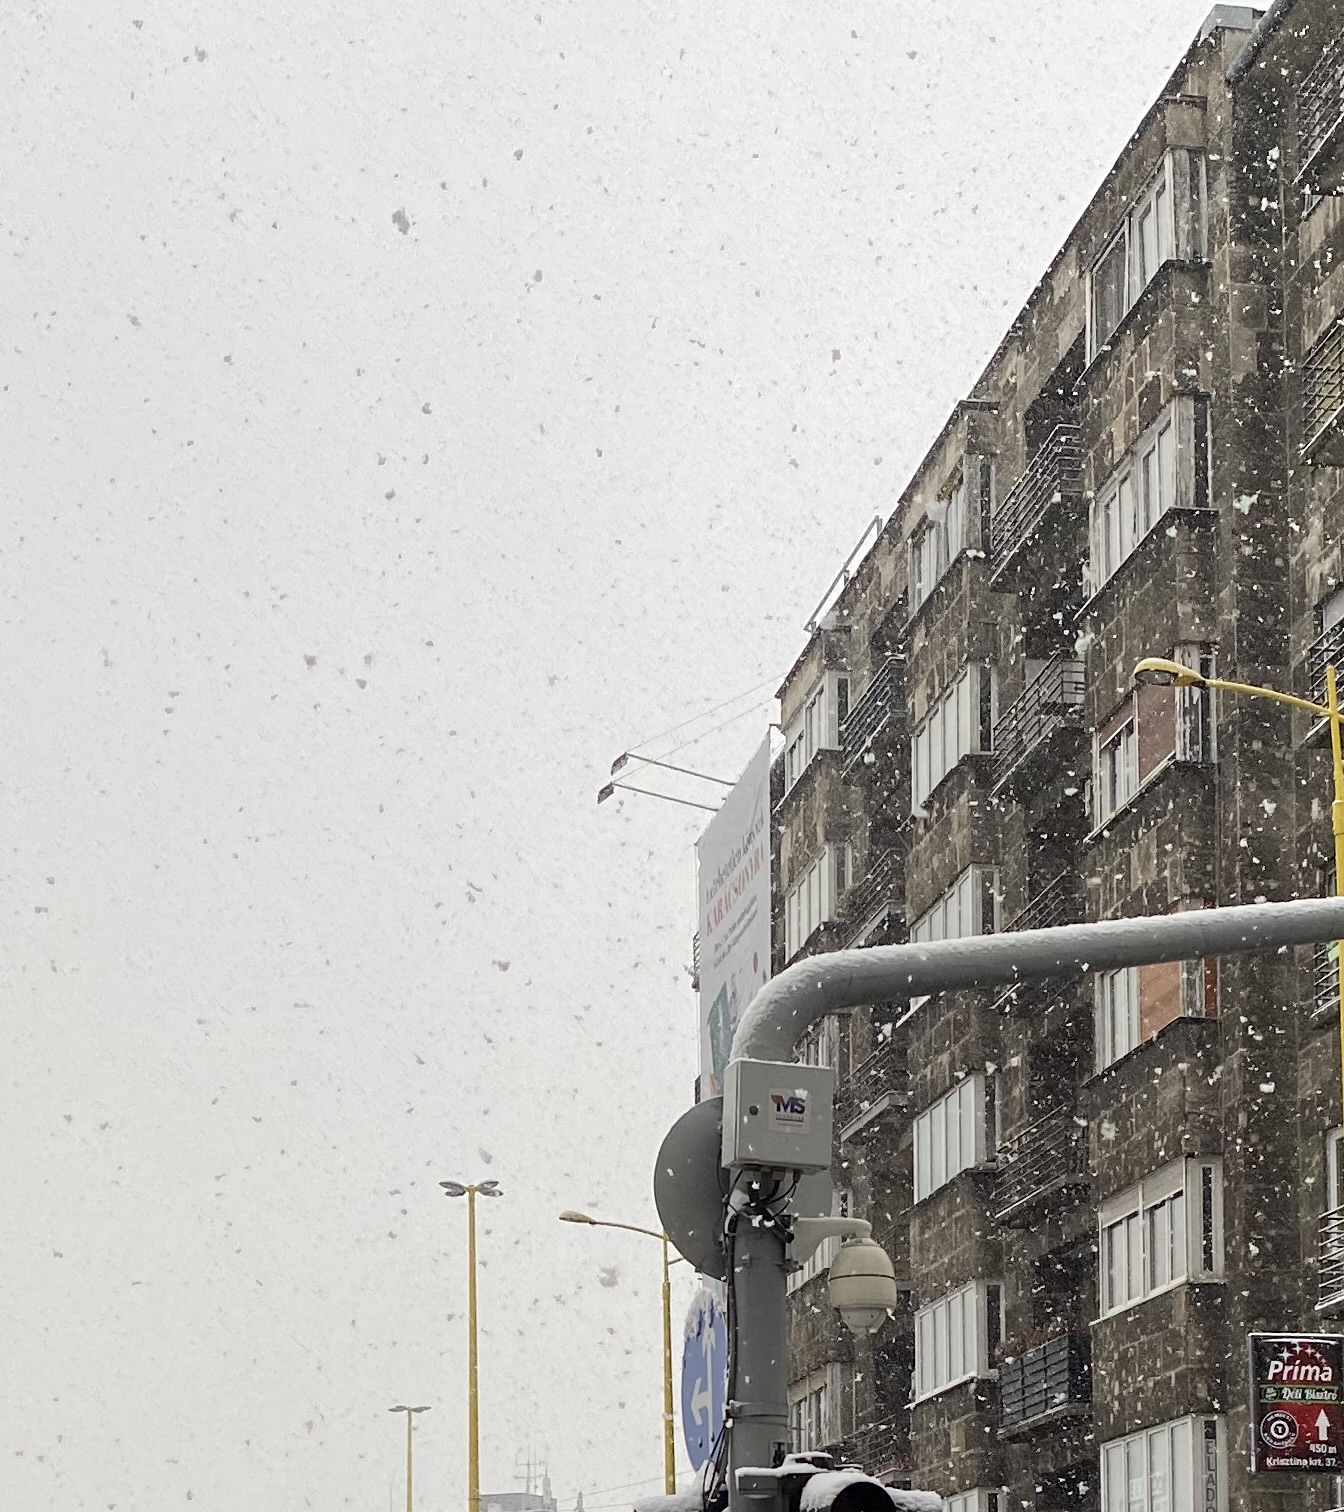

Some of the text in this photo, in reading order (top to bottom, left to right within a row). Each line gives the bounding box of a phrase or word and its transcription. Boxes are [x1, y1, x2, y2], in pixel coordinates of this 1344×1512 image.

[1268, 1360, 1333, 1382] Príma
[1310, 1444, 1337, 1454] 450 m
